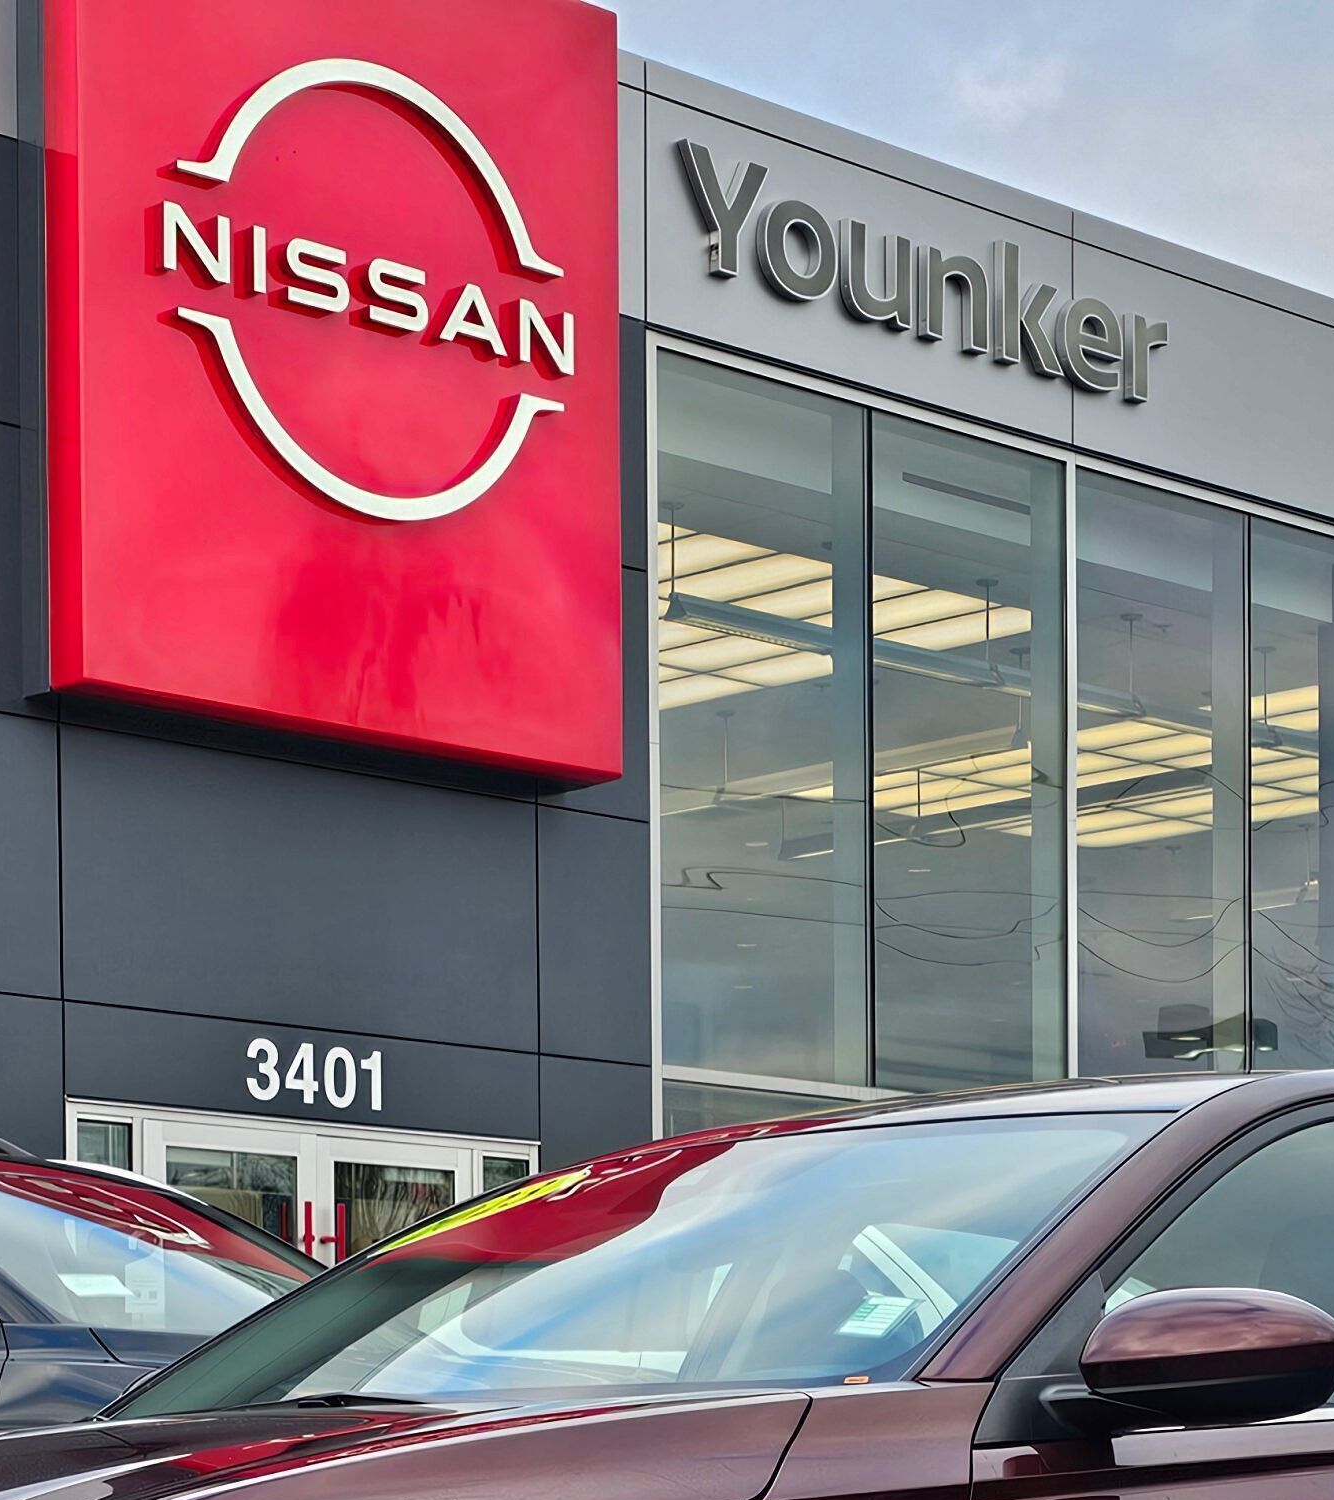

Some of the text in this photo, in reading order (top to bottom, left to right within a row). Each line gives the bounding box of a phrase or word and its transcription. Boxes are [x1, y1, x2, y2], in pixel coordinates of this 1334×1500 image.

[162, 199, 575, 377] NISSAN
[677, 138, 1168, 402] Younker
[246, 1038, 383, 1112] 3401
